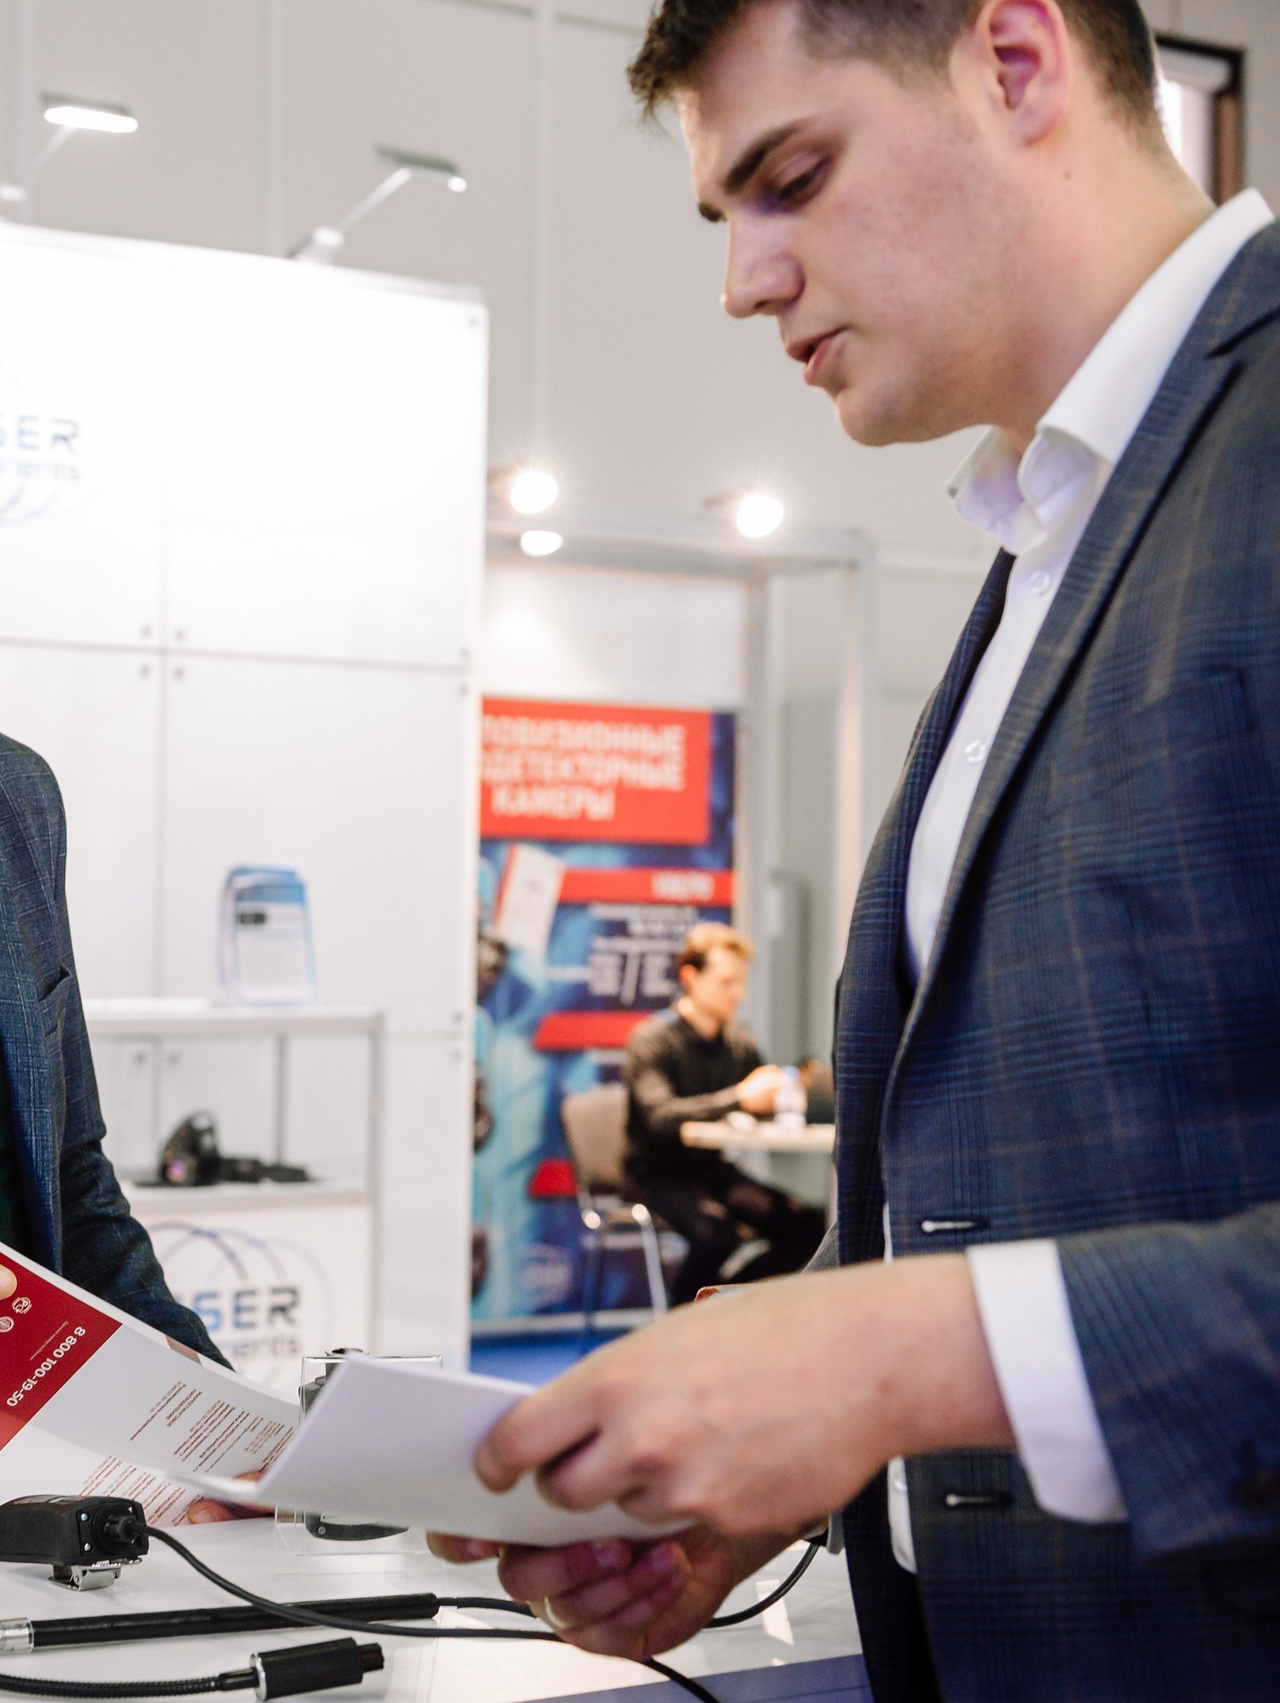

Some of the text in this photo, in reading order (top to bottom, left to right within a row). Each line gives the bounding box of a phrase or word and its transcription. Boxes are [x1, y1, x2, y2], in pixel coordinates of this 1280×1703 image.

[192, 1286, 300, 1332] SER
[52, 1335, 77, 1359] 800
[73, 1326, 86, 1337] 8
[6, 1357, 58, 1407] 100-19-50
